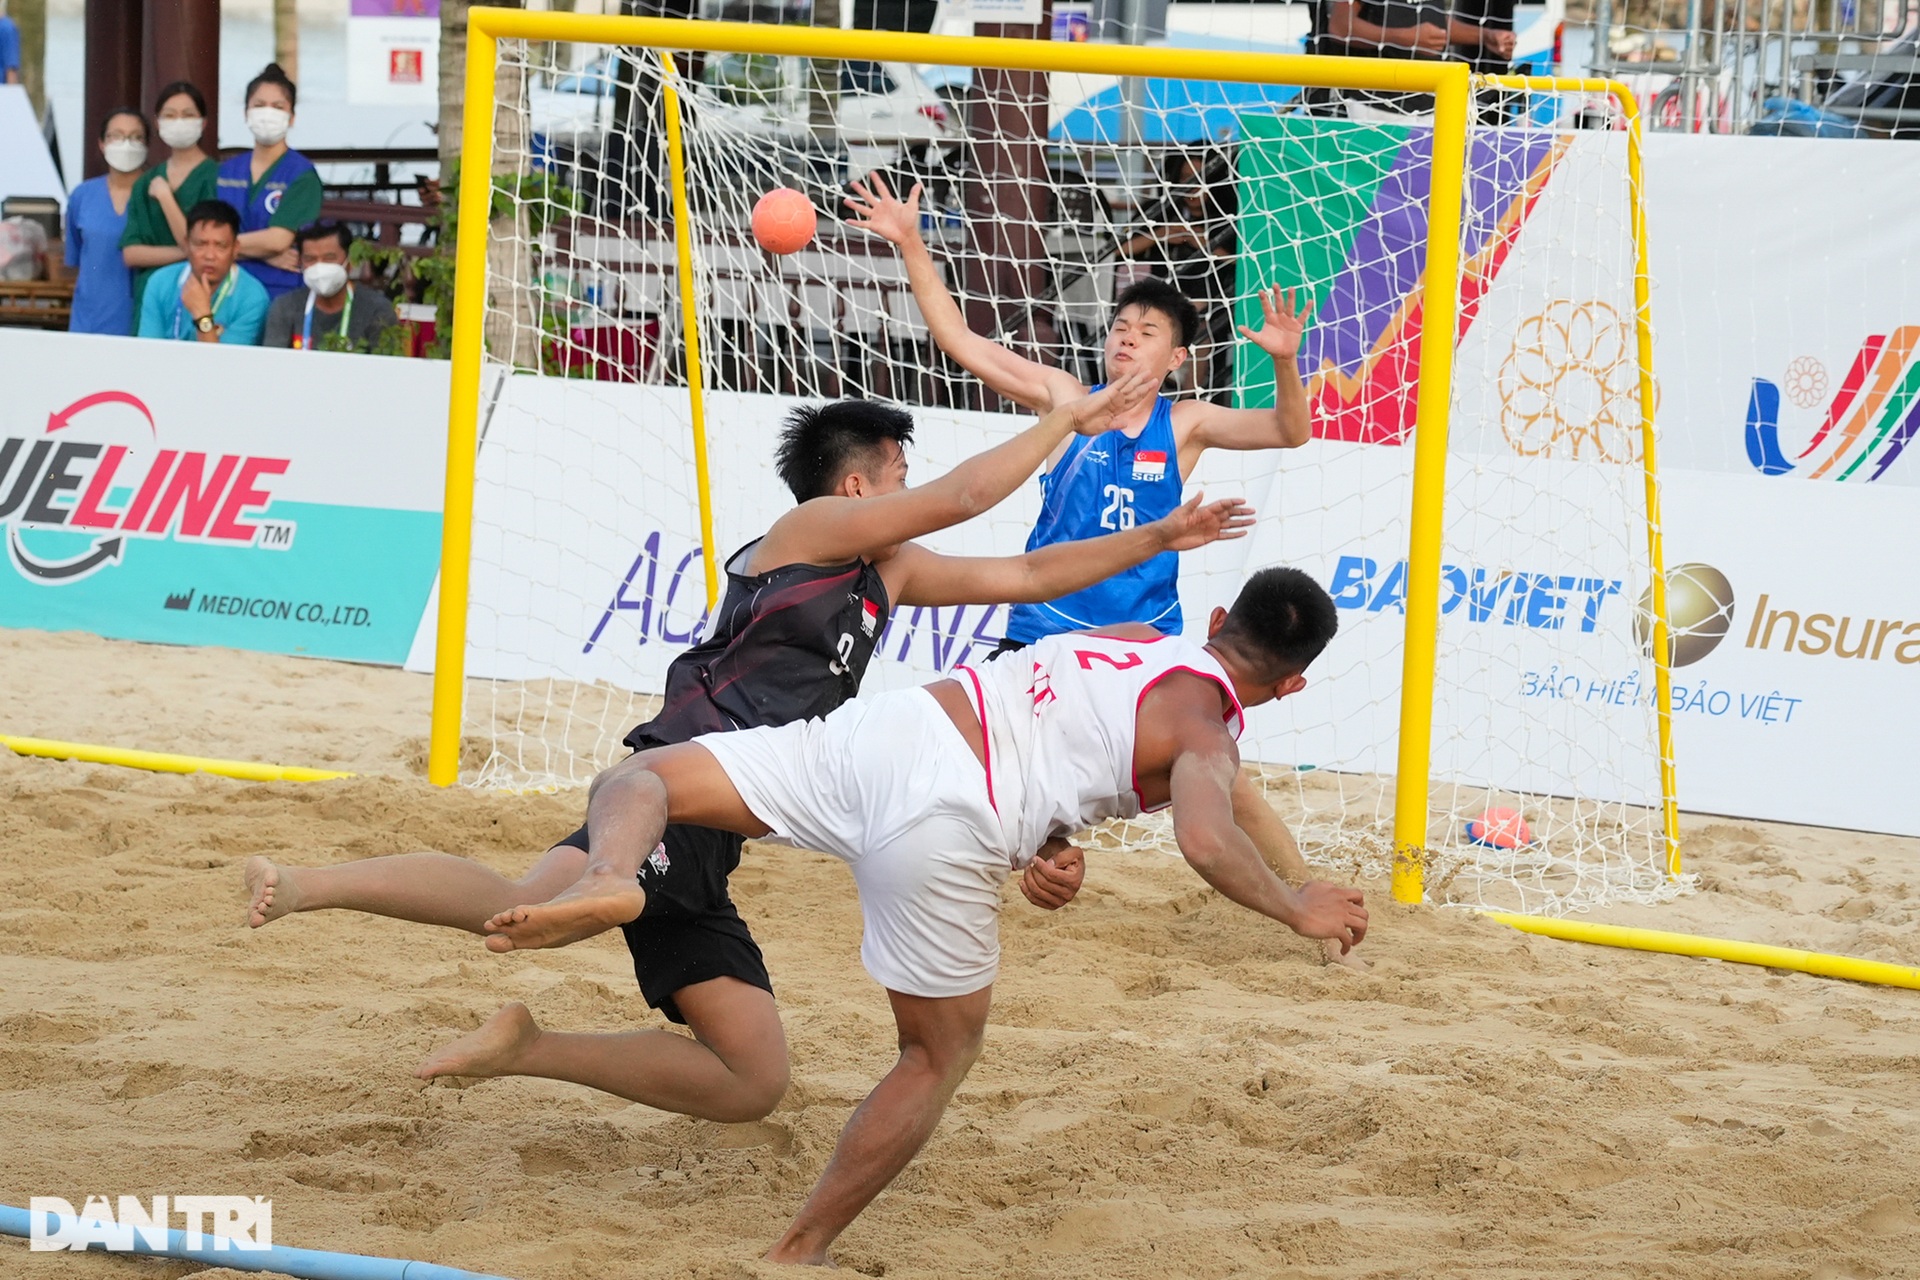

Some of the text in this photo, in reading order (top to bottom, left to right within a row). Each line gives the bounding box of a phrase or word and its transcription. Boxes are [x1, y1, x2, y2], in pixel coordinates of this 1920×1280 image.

[1132, 472, 1165, 482] SGP
[1100, 484, 1135, 531] 26
[198, 594, 292, 620] MEDICON
[1745, 594, 1920, 665] Insura
[829, 632, 855, 676] 9
[1074, 650, 1144, 670] 2
[1519, 665, 1580, 699] BẢO
[1671, 680, 1730, 716] BẢO
[1740, 690, 1802, 726] VIỆT
